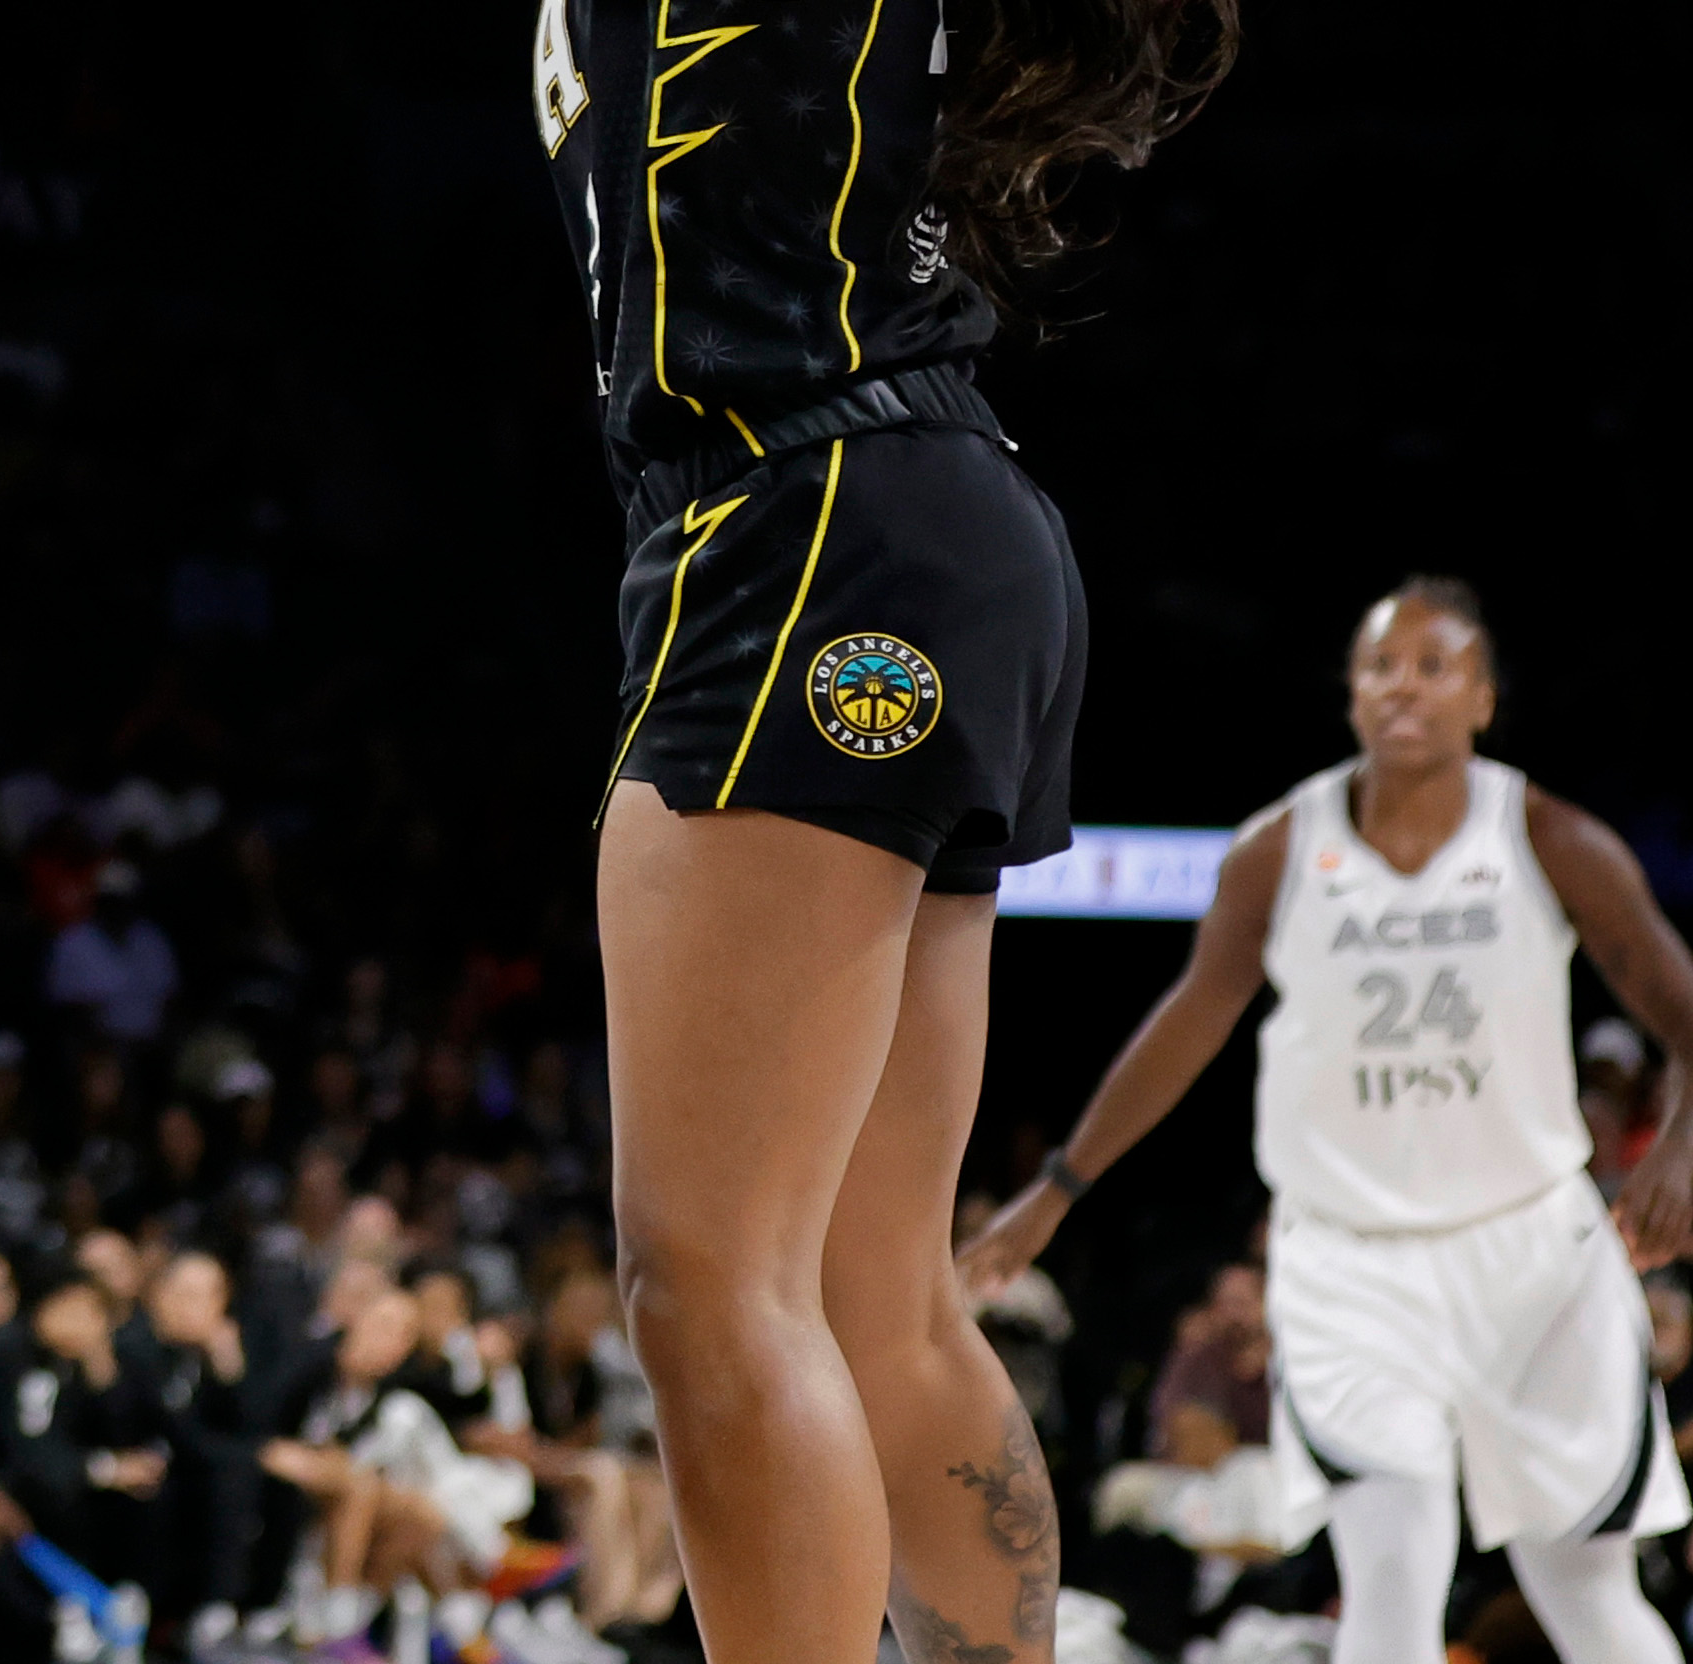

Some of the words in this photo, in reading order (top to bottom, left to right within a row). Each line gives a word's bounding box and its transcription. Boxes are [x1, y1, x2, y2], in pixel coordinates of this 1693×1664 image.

[814, 652, 839, 694] LOS
[846, 637, 936, 700] ANGELES
[827, 719, 920, 753] SPARKS
[1328, 909, 1503, 956] ACES
[1358, 966, 1483, 1047] 24
